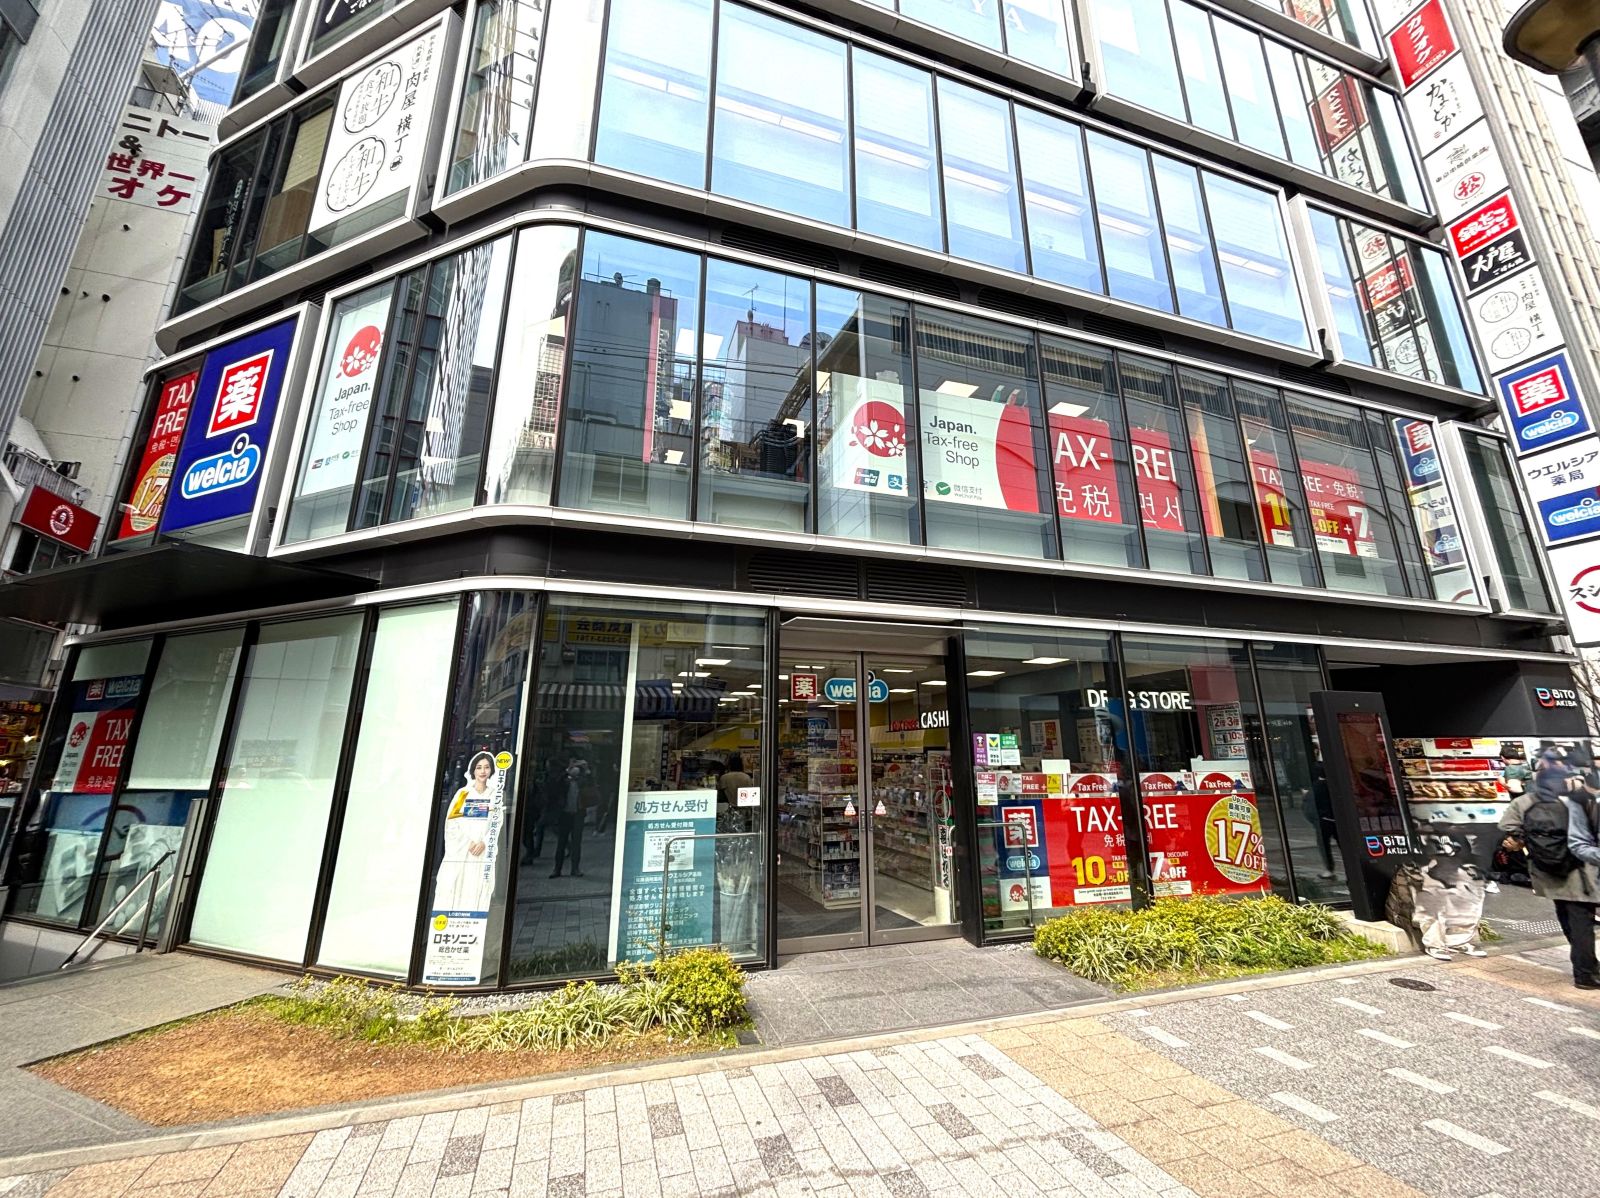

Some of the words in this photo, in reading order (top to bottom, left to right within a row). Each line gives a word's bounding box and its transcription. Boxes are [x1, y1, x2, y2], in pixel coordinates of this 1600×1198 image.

[1407, 14, 1433, 65] カラオケ
[123, 112, 209, 141] ニトー
[119, 134, 142, 153] &
[106, 152, 195, 181] 世界一
[108, 177, 191, 206] オケ
[1457, 174, 1481, 197] 松
[217, 364, 262, 424] 薬
[334, 381, 371, 402] Japan.
[1518, 373, 1560, 409] 薬
[329, 400, 370, 421] Tax-free
[153, 408, 188, 438] FRE
[331, 418, 358, 436] Shop
[929, 415, 977, 435] Japan.
[1525, 415, 1573, 439] welcia
[924, 431, 979, 452] Tax-free
[945, 450, 980, 469] Shop
[1527, 450, 1599, 480] ウエルシア
[188, 453, 250, 491] welcia
[1551, 469, 1585, 487] 薬局
[1302, 475, 1325, 493] REE
[1056, 481, 1112, 518] 免税
[1347, 505, 1369, 539] 7
[795, 677, 814, 697] 薬
[830, 680, 882, 698] welia
[1087, 689, 1135, 710] DRG
[1139, 690, 1192, 710] STORE
[1555, 700, 1577, 708] AKIBA
[105, 718, 134, 741] TAX
[921, 709, 949, 729] CASHI
[1077, 783, 1091, 792] Tax
[1092, 782, 1107, 791] Free
[1143, 782, 1156, 790] Tax
[1157, 782, 1172, 790] Free
[1203, 780, 1217, 789] Tax
[1217, 780, 1232, 788] Free
[633, 798, 709, 815] 処方せん受付
[1007, 812, 1033, 843] 薬
[1071, 855, 1107, 887] 10
[1149, 851, 1165, 880] 7
[1243, 853, 1268, 872] OFF
[433, 933, 478, 945] ロキソニン
